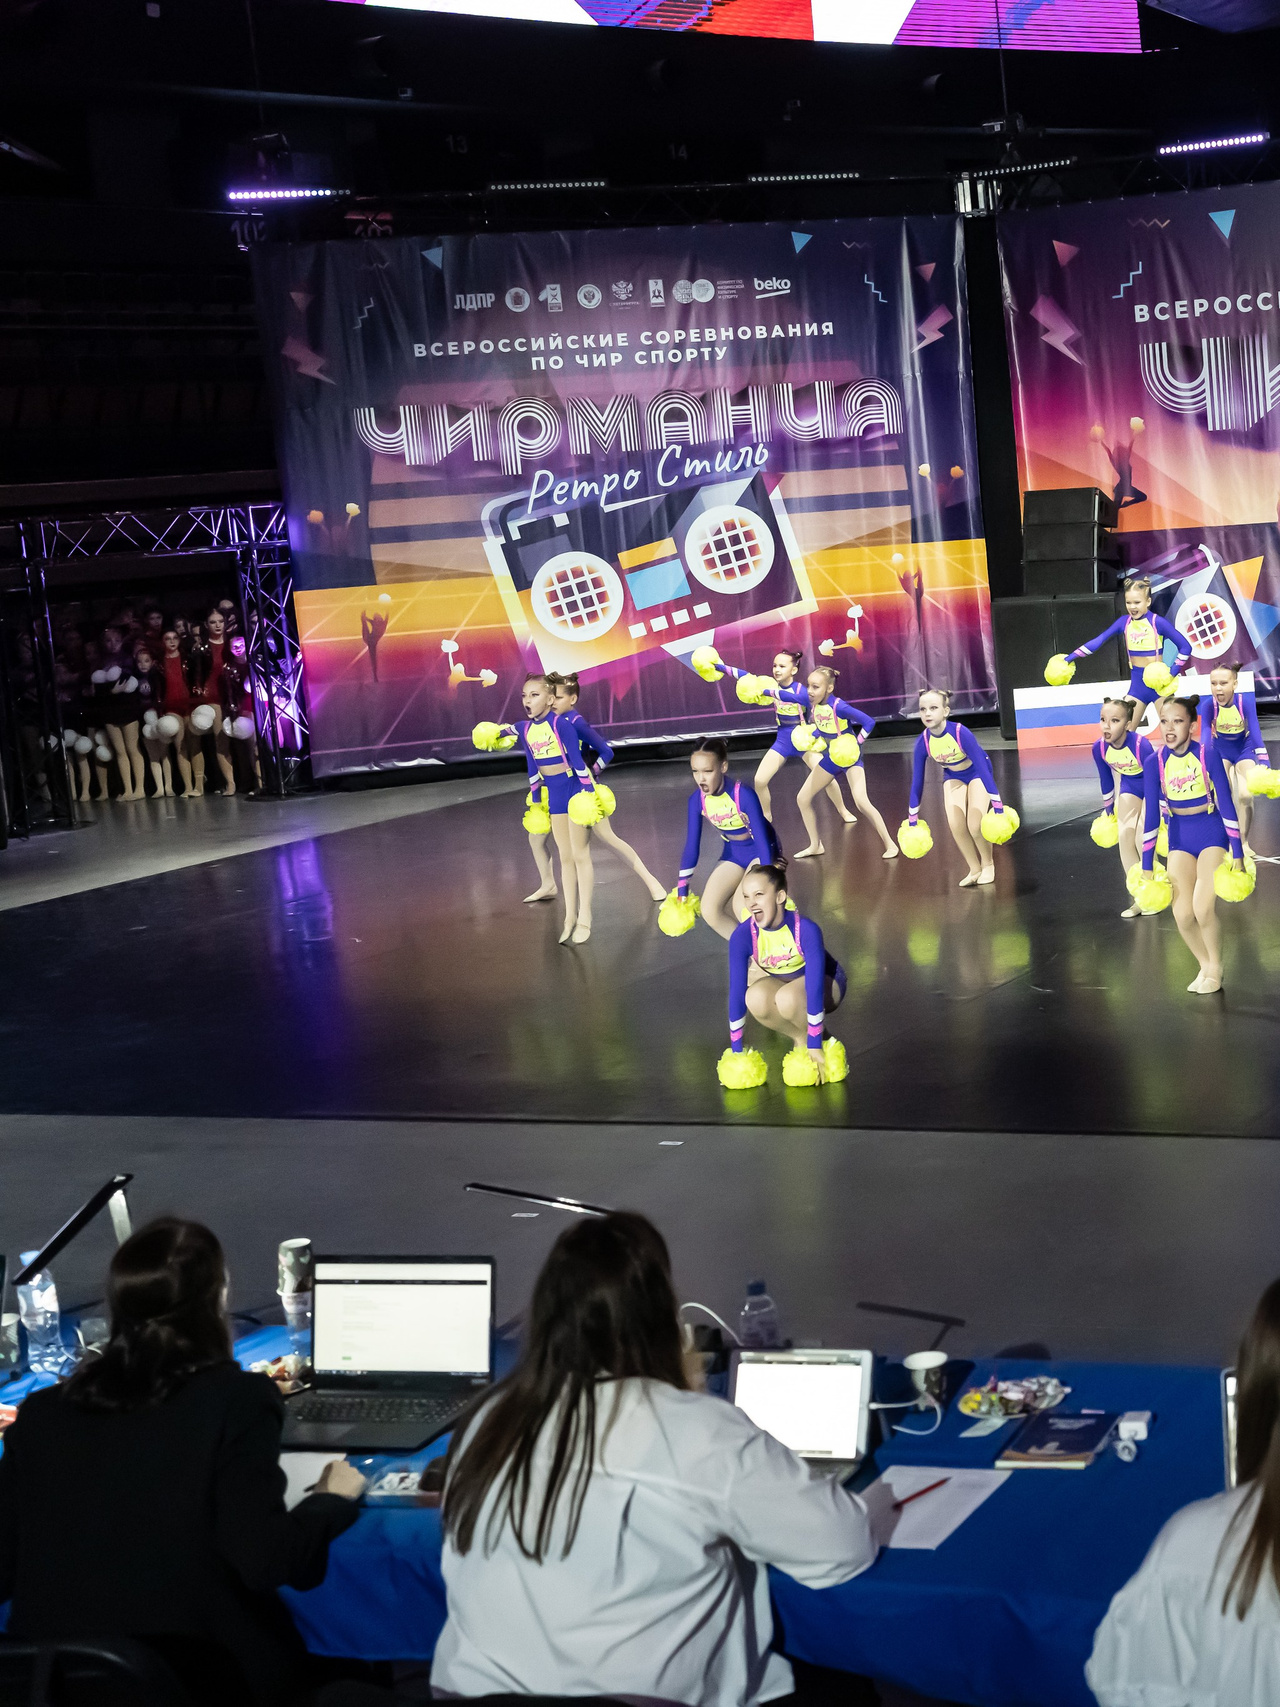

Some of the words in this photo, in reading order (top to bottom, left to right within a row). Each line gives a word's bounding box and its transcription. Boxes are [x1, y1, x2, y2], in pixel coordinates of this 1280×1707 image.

[754, 276, 791, 291] beko
[453, 292, 496, 312] ЛДПР
[413, 332, 629, 357] ВСЕРОССИЙСКИЕ
[640, 321, 834, 345] СОРЕВНОВАНИЯ
[532, 356, 564, 371] ПО
[575, 353, 623, 368] ЧИР
[635, 346, 728, 364] СПОРТУ
[527, 468, 641, 515] Ретро
[656, 443, 769, 487] Стиль
